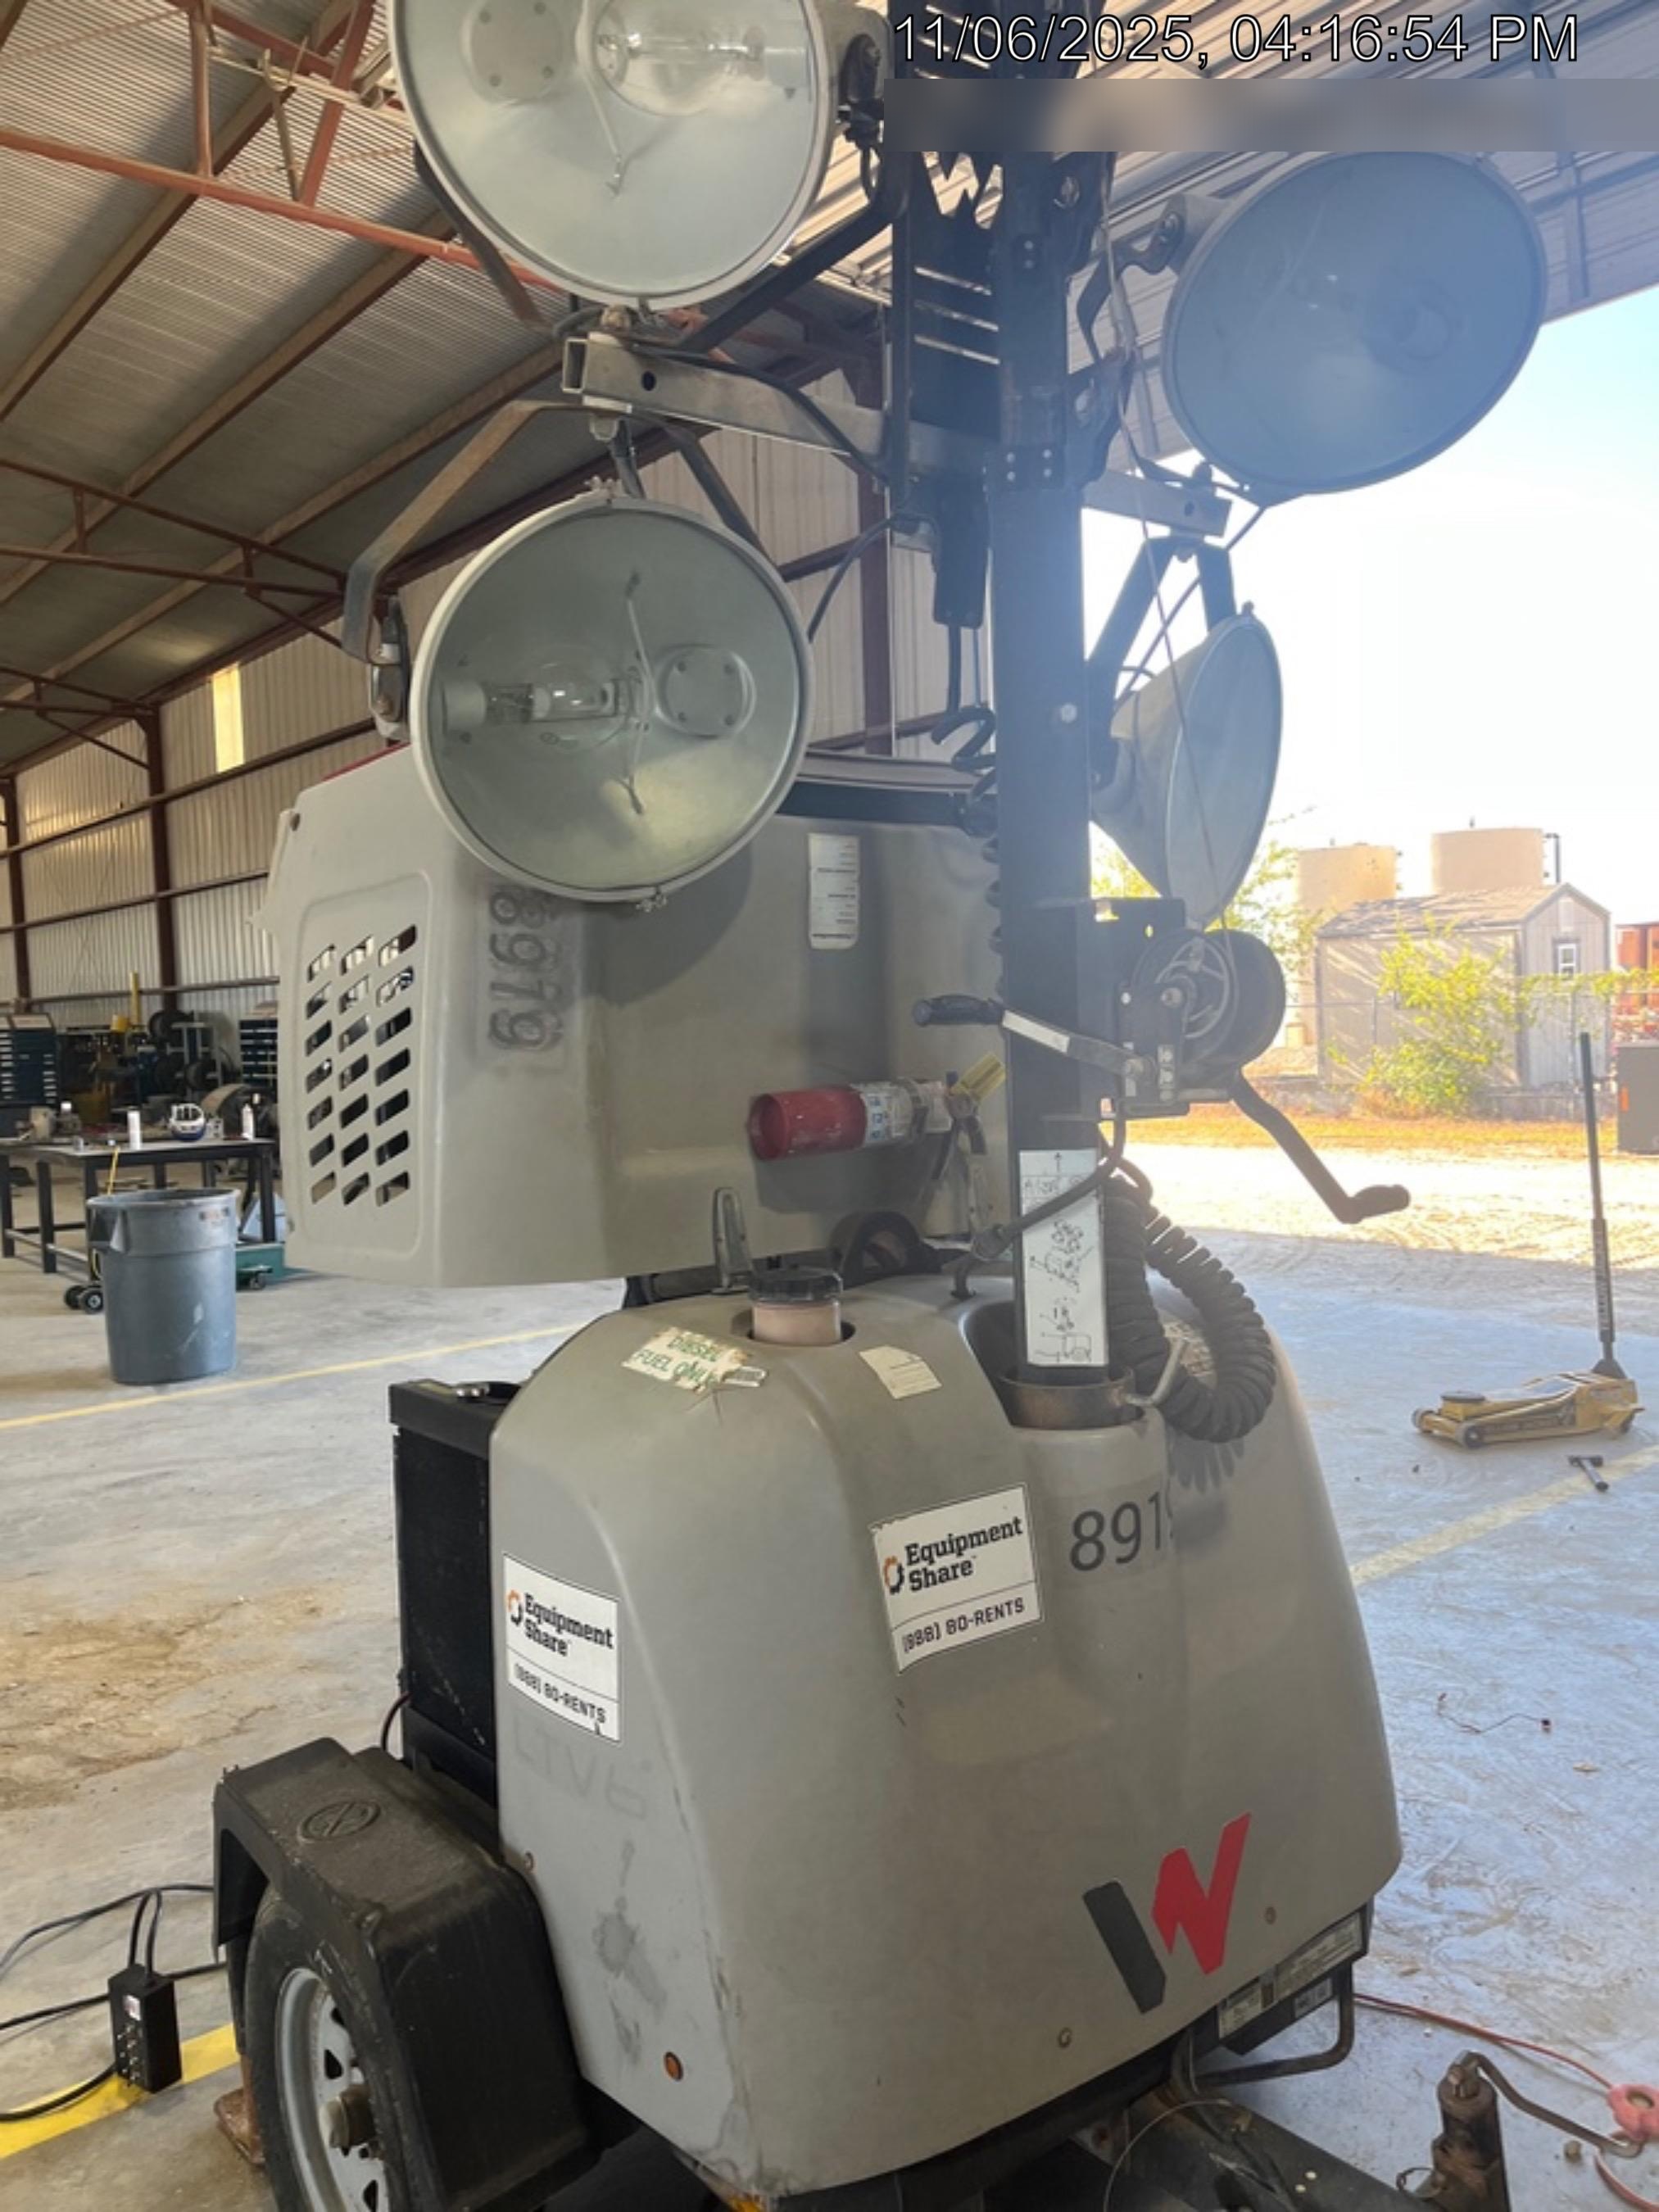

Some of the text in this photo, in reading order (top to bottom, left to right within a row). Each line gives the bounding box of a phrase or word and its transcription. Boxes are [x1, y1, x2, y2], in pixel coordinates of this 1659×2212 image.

[904, 1516, 1023, 1566] Equipment
[1070, 1477, 1174, 1571] 891
[909, 1560, 974, 1591] Share
[525, 1593, 614, 1649] Equipment
[525, 1618, 568, 1657] Share
